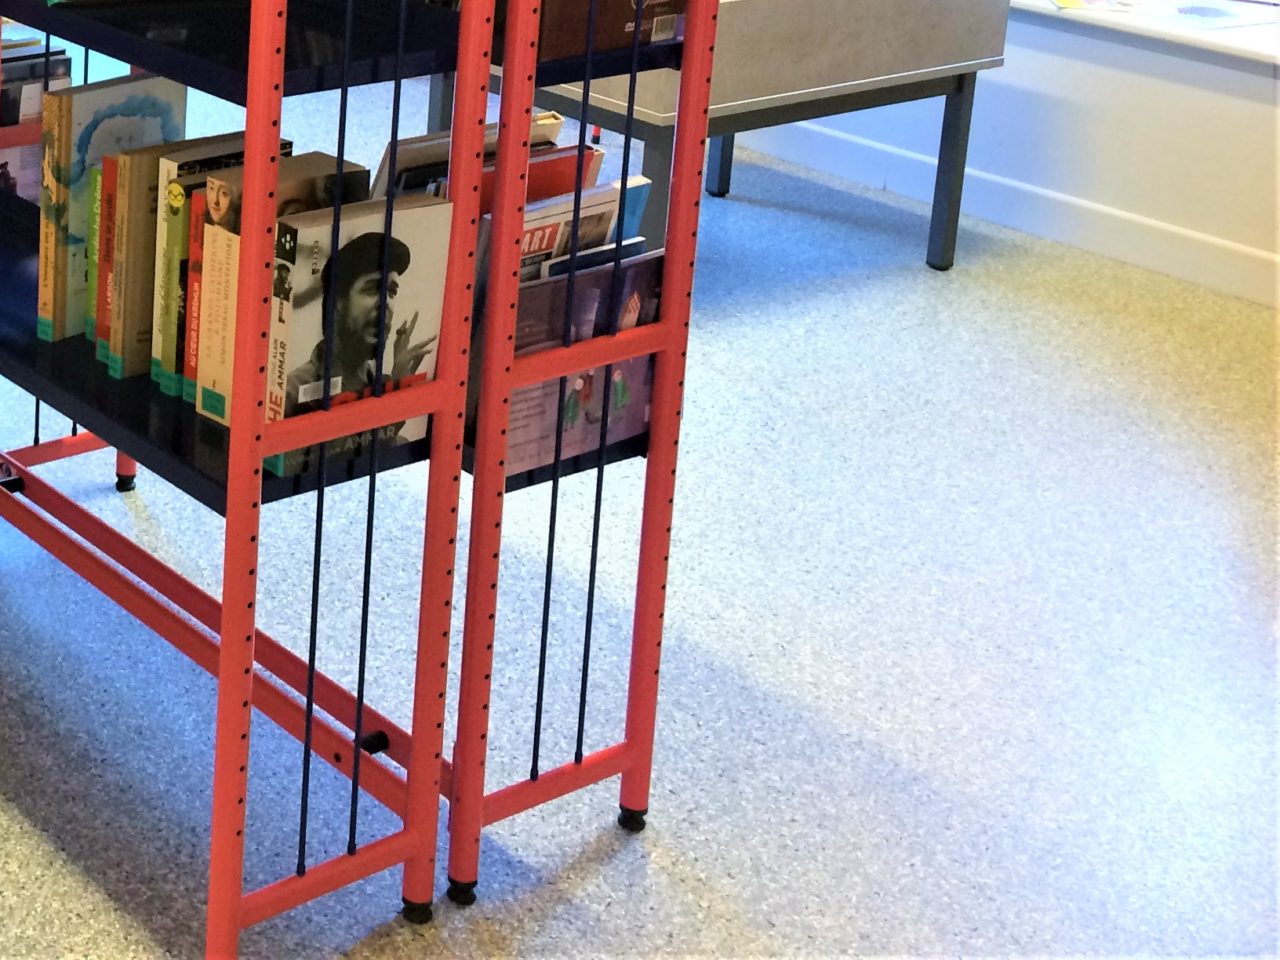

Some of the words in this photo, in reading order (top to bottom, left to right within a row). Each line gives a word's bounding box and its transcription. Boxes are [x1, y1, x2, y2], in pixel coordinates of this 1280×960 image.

[94, 174, 102, 213] Drôme
[92, 214, 100, 262] Ardèche
[191, 281, 199, 316] KREMLIN
[189, 353, 196, 367] AU
[276, 341, 288, 391] AMMAR
[268, 391, 284, 424] HE
